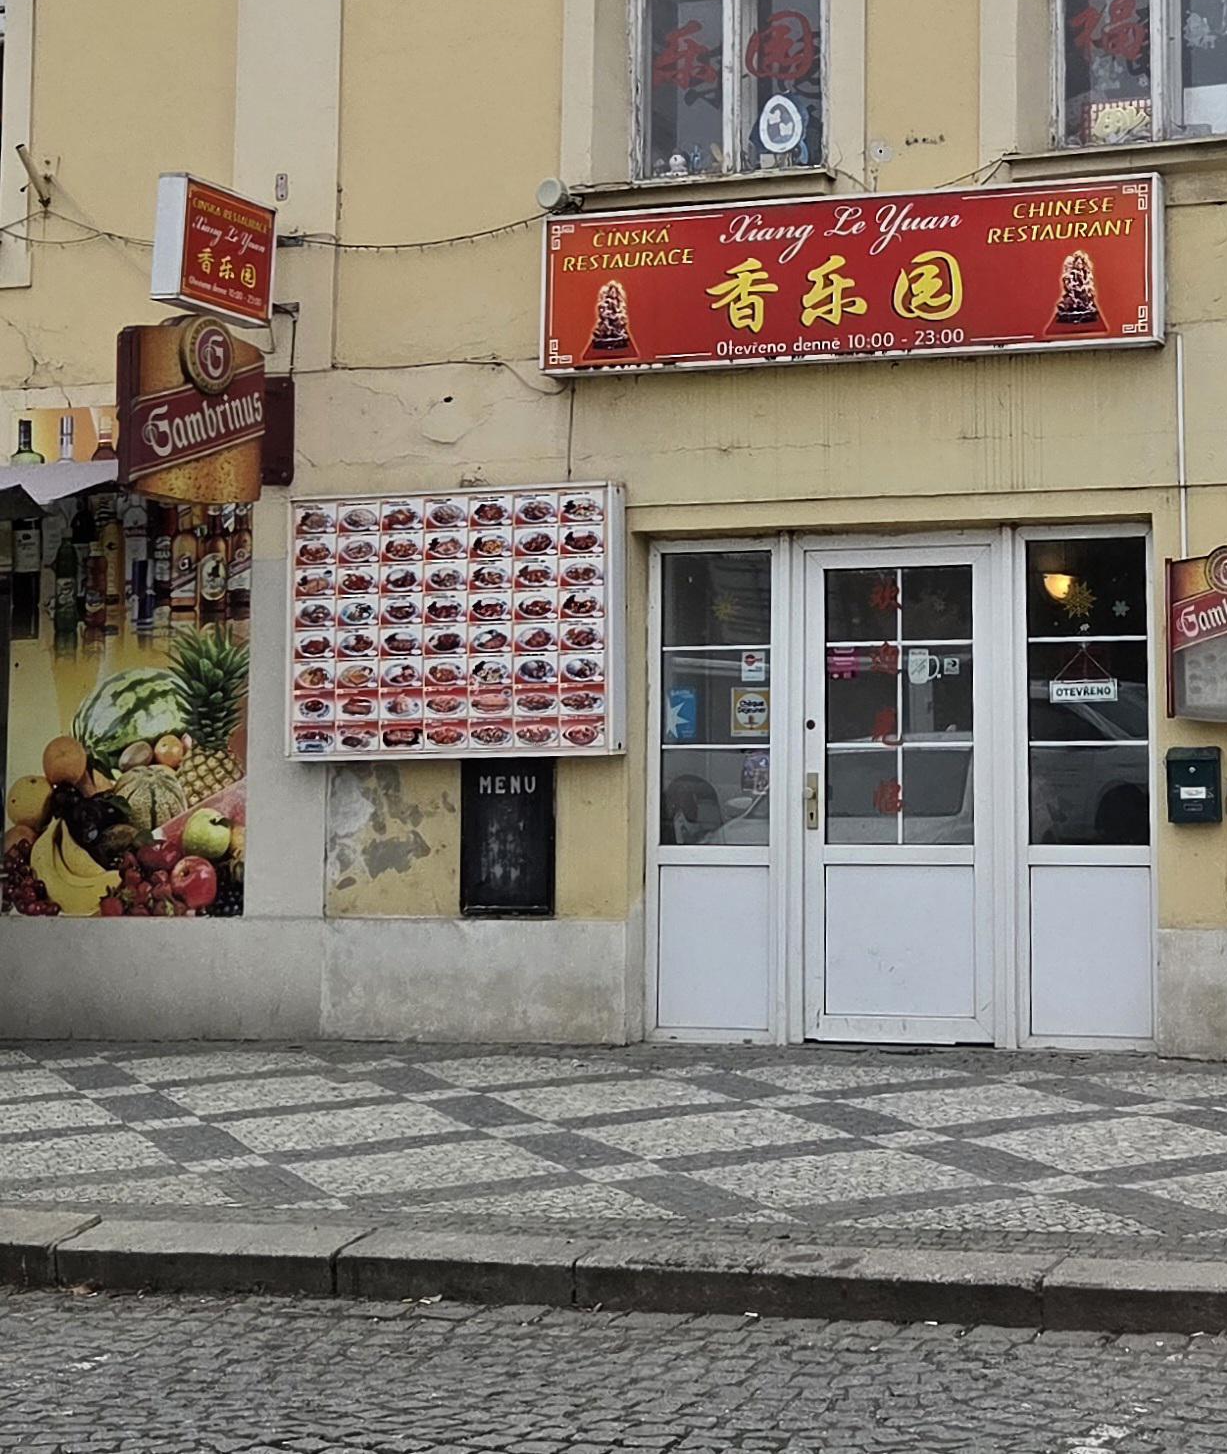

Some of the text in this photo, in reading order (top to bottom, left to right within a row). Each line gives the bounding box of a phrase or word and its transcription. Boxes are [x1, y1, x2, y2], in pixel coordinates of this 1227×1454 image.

[1013, 196, 1115, 219] CHINESE
[593, 224, 671, 248] ČÍNSKÁ
[719, 202, 963, 264] Xiang Le Yuan
[987, 218, 1135, 244] RESTAURANT
[563, 248, 695, 272] RESTAURACE
[717, 338, 787, 356] Otevřeno
[793, 336, 840, 352] denně
[848, 331, 894, 349] 10:00
[914, 328, 965, 346] 23:00
[142, 391, 263, 457] Gambrinus
[479, 775, 536, 795] MENU
